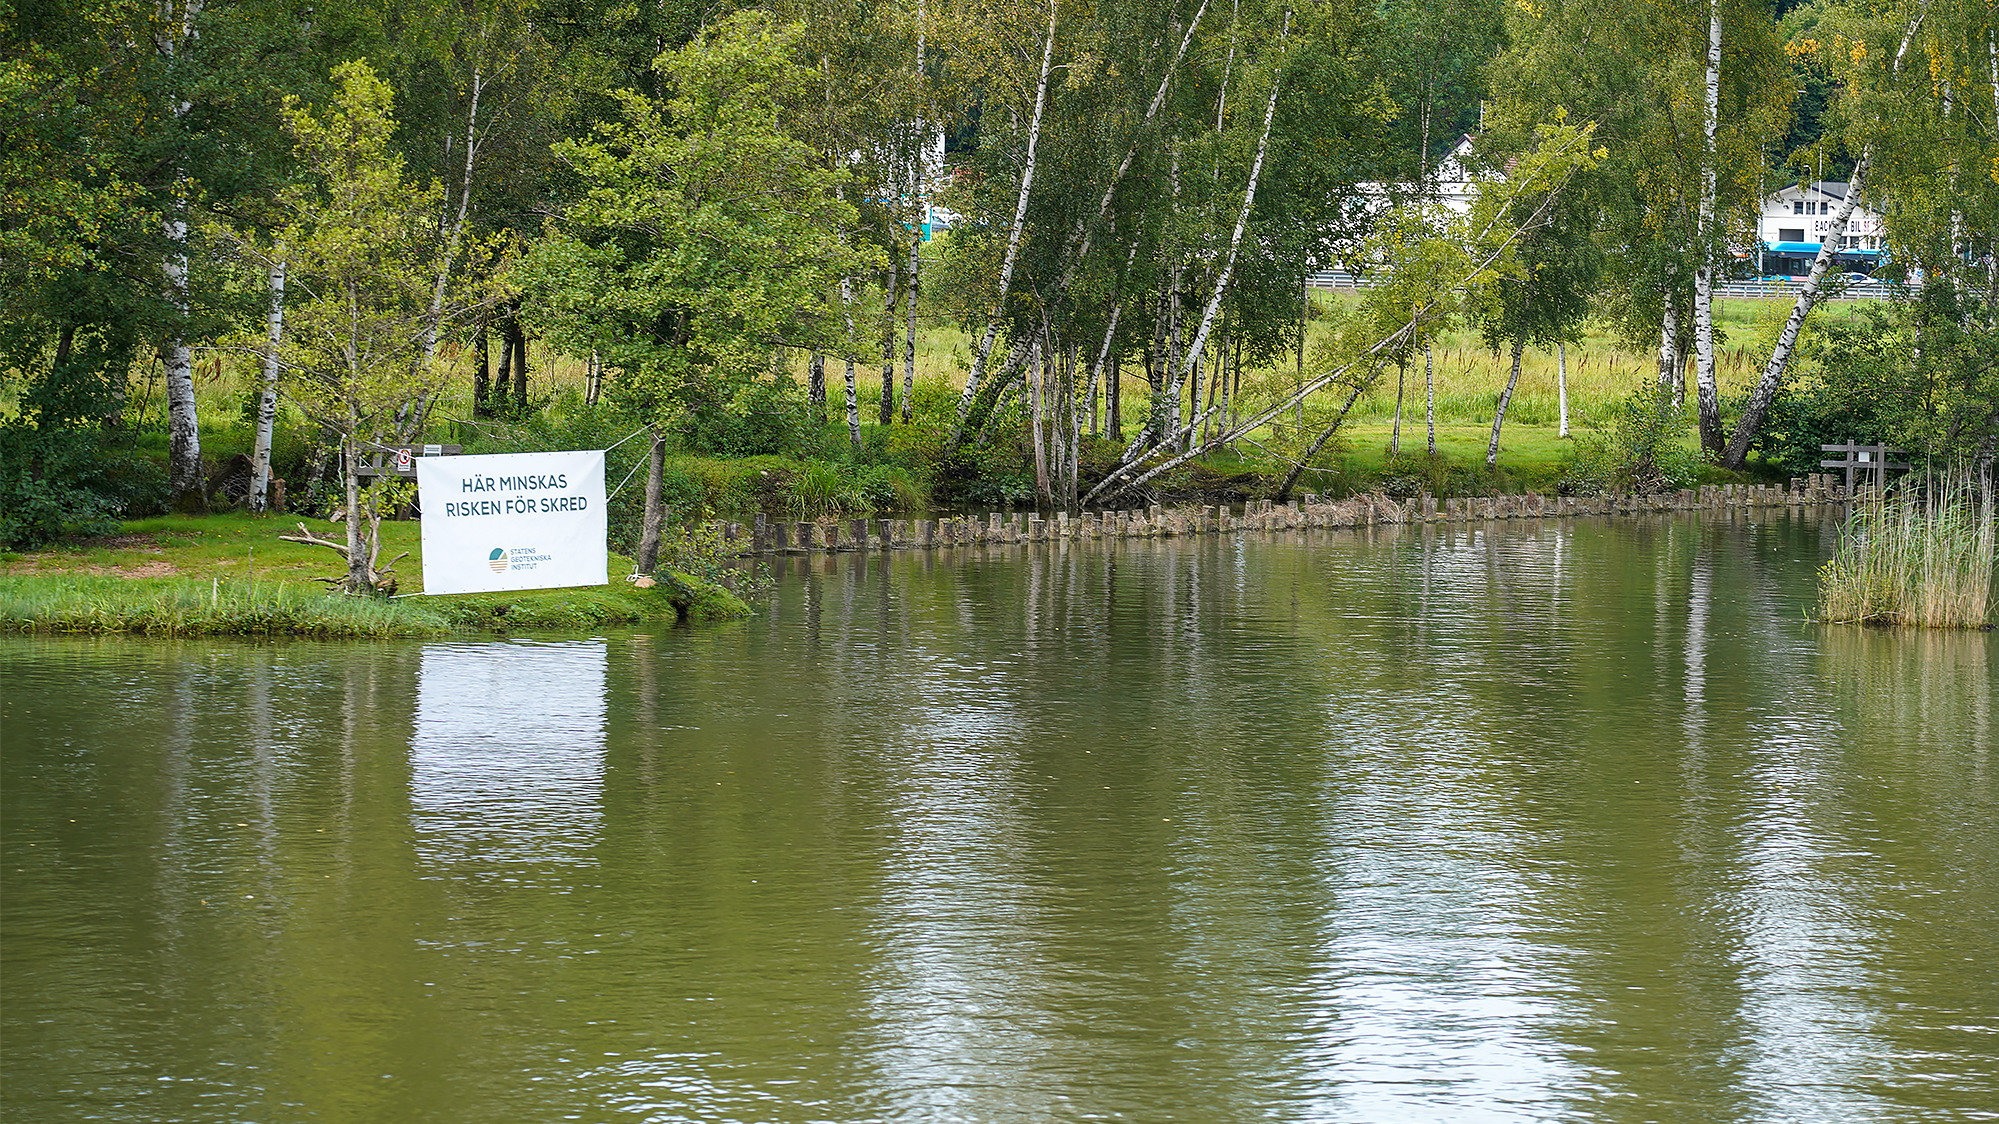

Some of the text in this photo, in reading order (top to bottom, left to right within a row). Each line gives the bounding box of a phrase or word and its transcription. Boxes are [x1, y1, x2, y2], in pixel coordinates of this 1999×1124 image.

[1850, 220, 1861, 232] BIL
[462, 474, 568, 493] HÄR MINSKAS
[446, 495, 588, 517] RISKEN FÖR SKRED
[510, 547, 537, 556] STATENS
[510, 554, 552, 563] GEOTEKNISKA
[511, 562, 537, 571] INSTITUT
